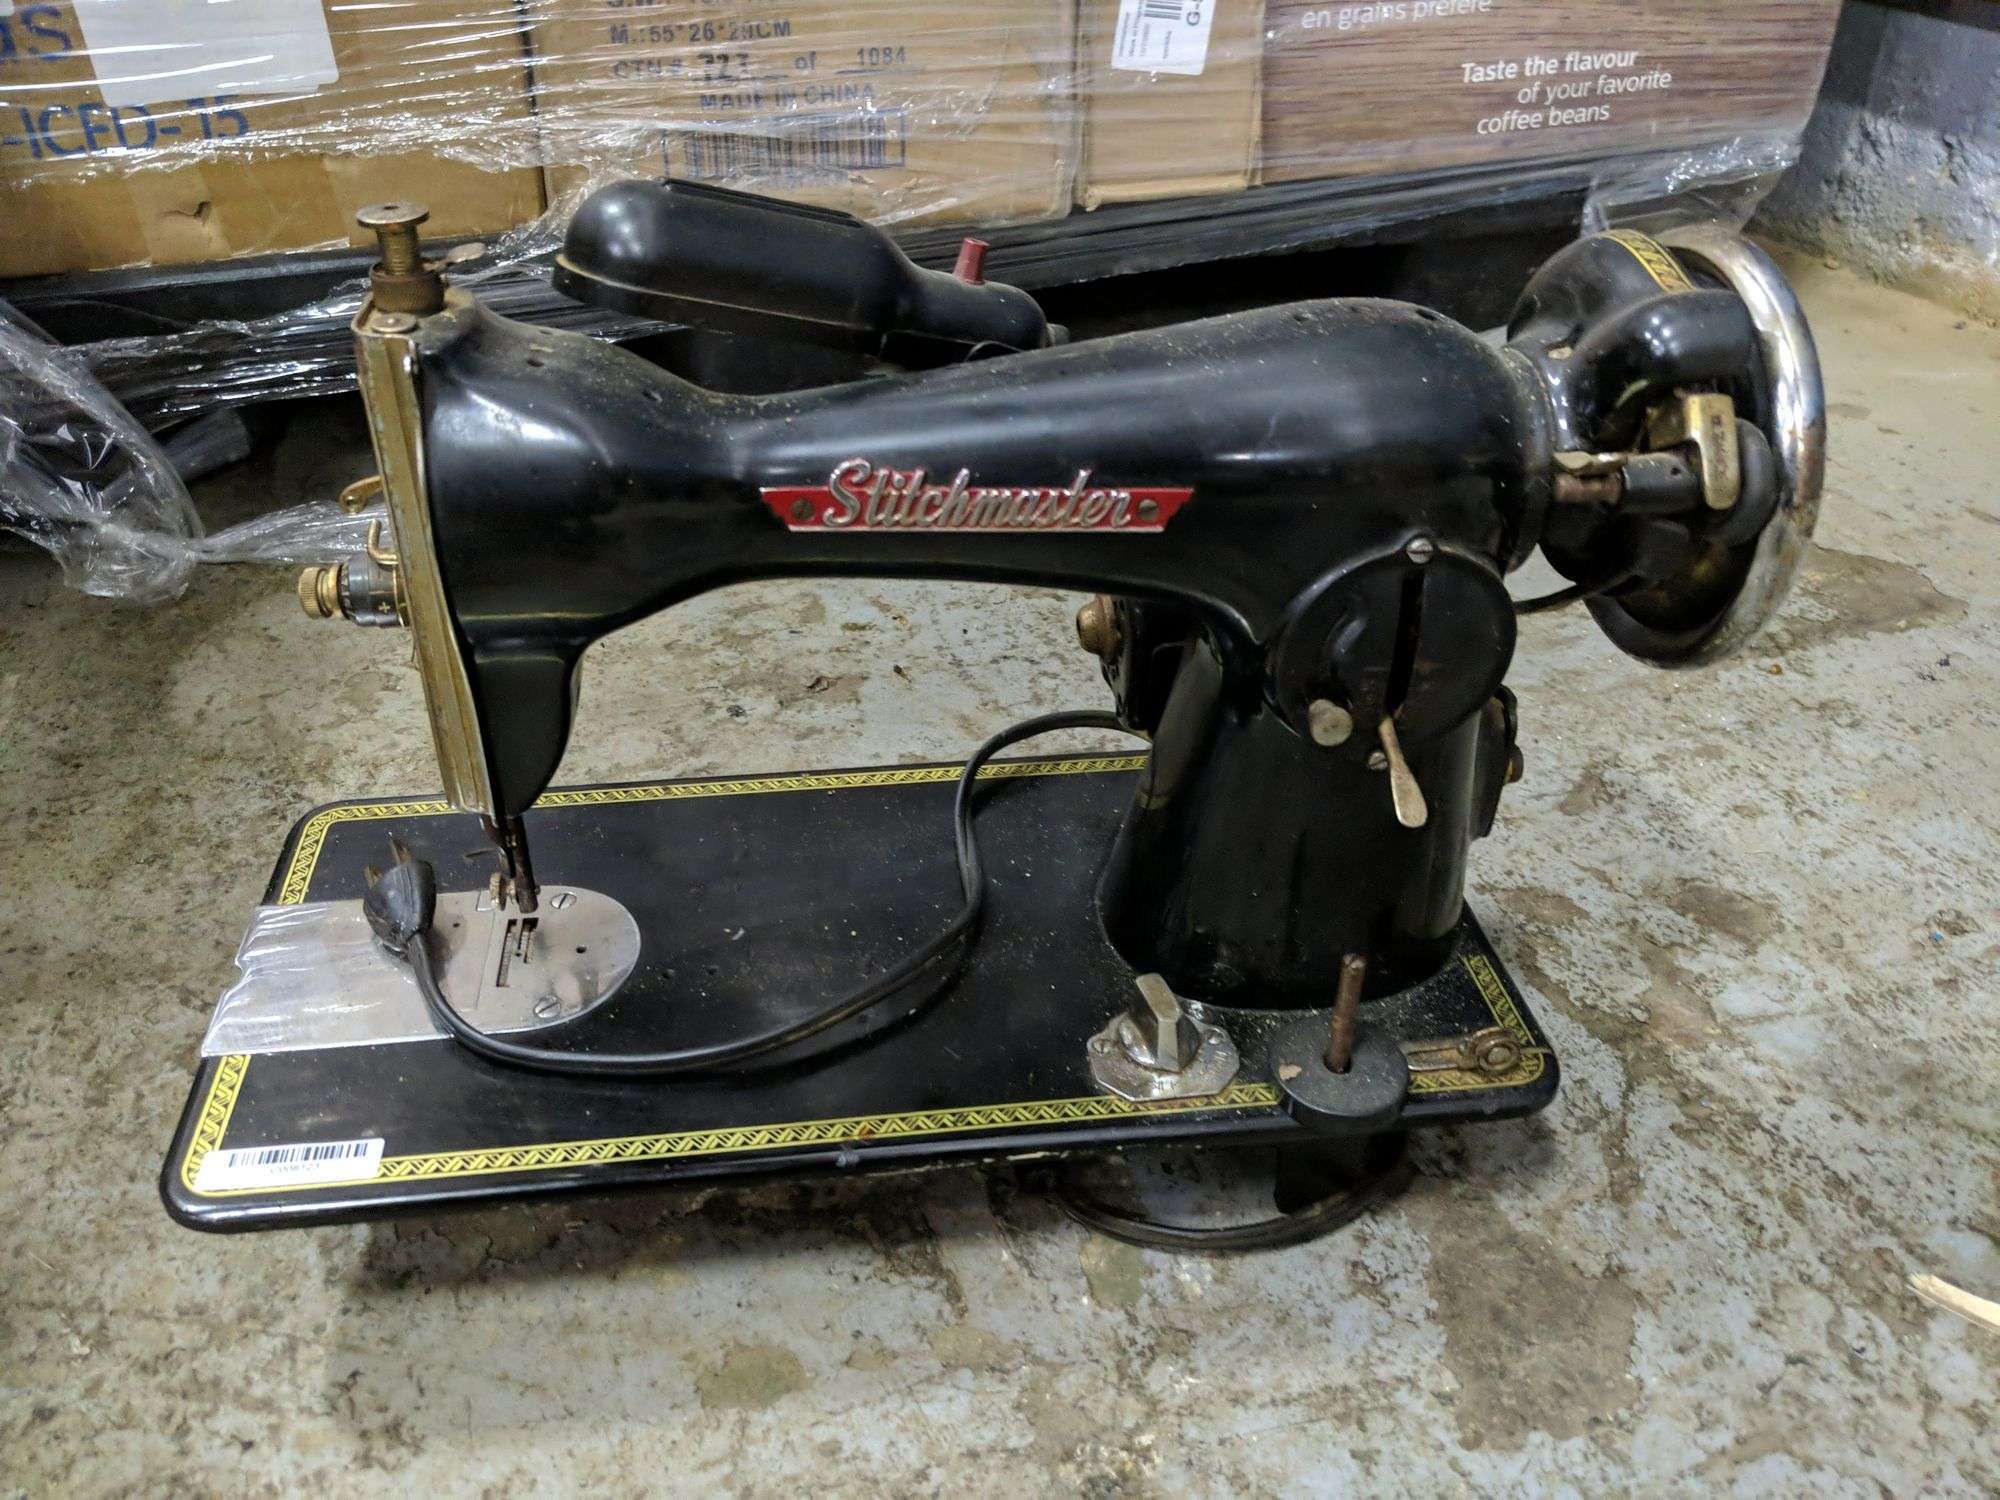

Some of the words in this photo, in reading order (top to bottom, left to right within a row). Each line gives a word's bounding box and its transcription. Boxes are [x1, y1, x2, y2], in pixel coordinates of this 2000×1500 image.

[1302, 9, 1331, 29] en
[1337, 3, 1406, 30] grains
[794, 50, 817, 71] of
[857, 46, 906, 66] 1084
[1461, 60, 1518, 83] Taste
[1524, 54, 1559, 77] the
[1564, 50, 1639, 73] flavour
[804, 81, 874, 105] CHINA
[1517, 81, 1542, 104] of
[1543, 79, 1592, 106] your
[1596, 69, 1673, 95] favorite
[1476, 107, 1543, 135] coffee
[1547, 103, 1611, 127] beans
[824, 458, 1132, 528] Stitchmaster
